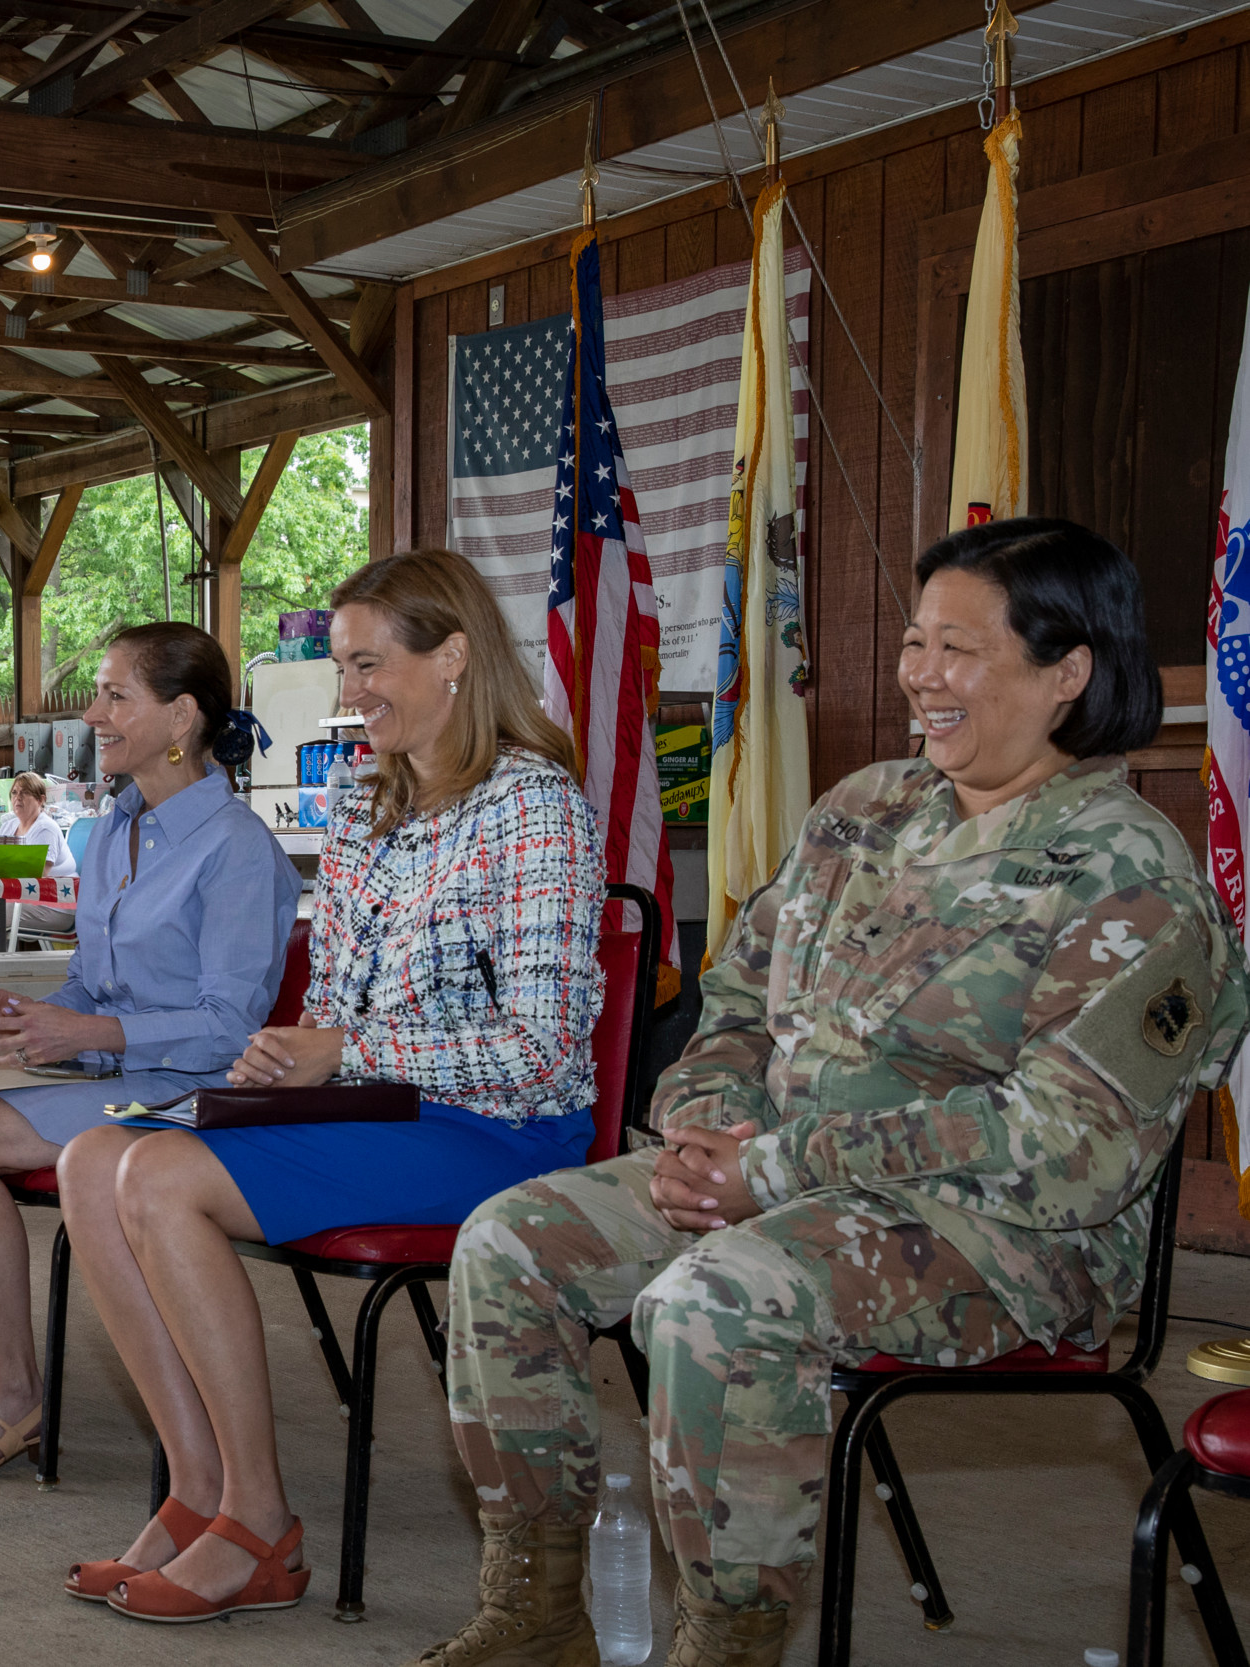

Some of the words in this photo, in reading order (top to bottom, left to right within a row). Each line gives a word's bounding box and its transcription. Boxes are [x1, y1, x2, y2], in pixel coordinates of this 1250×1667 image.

[664, 620, 697, 635] personnel
[671, 635, 680, 646] of
[316, 752, 324, 776] pepsi
